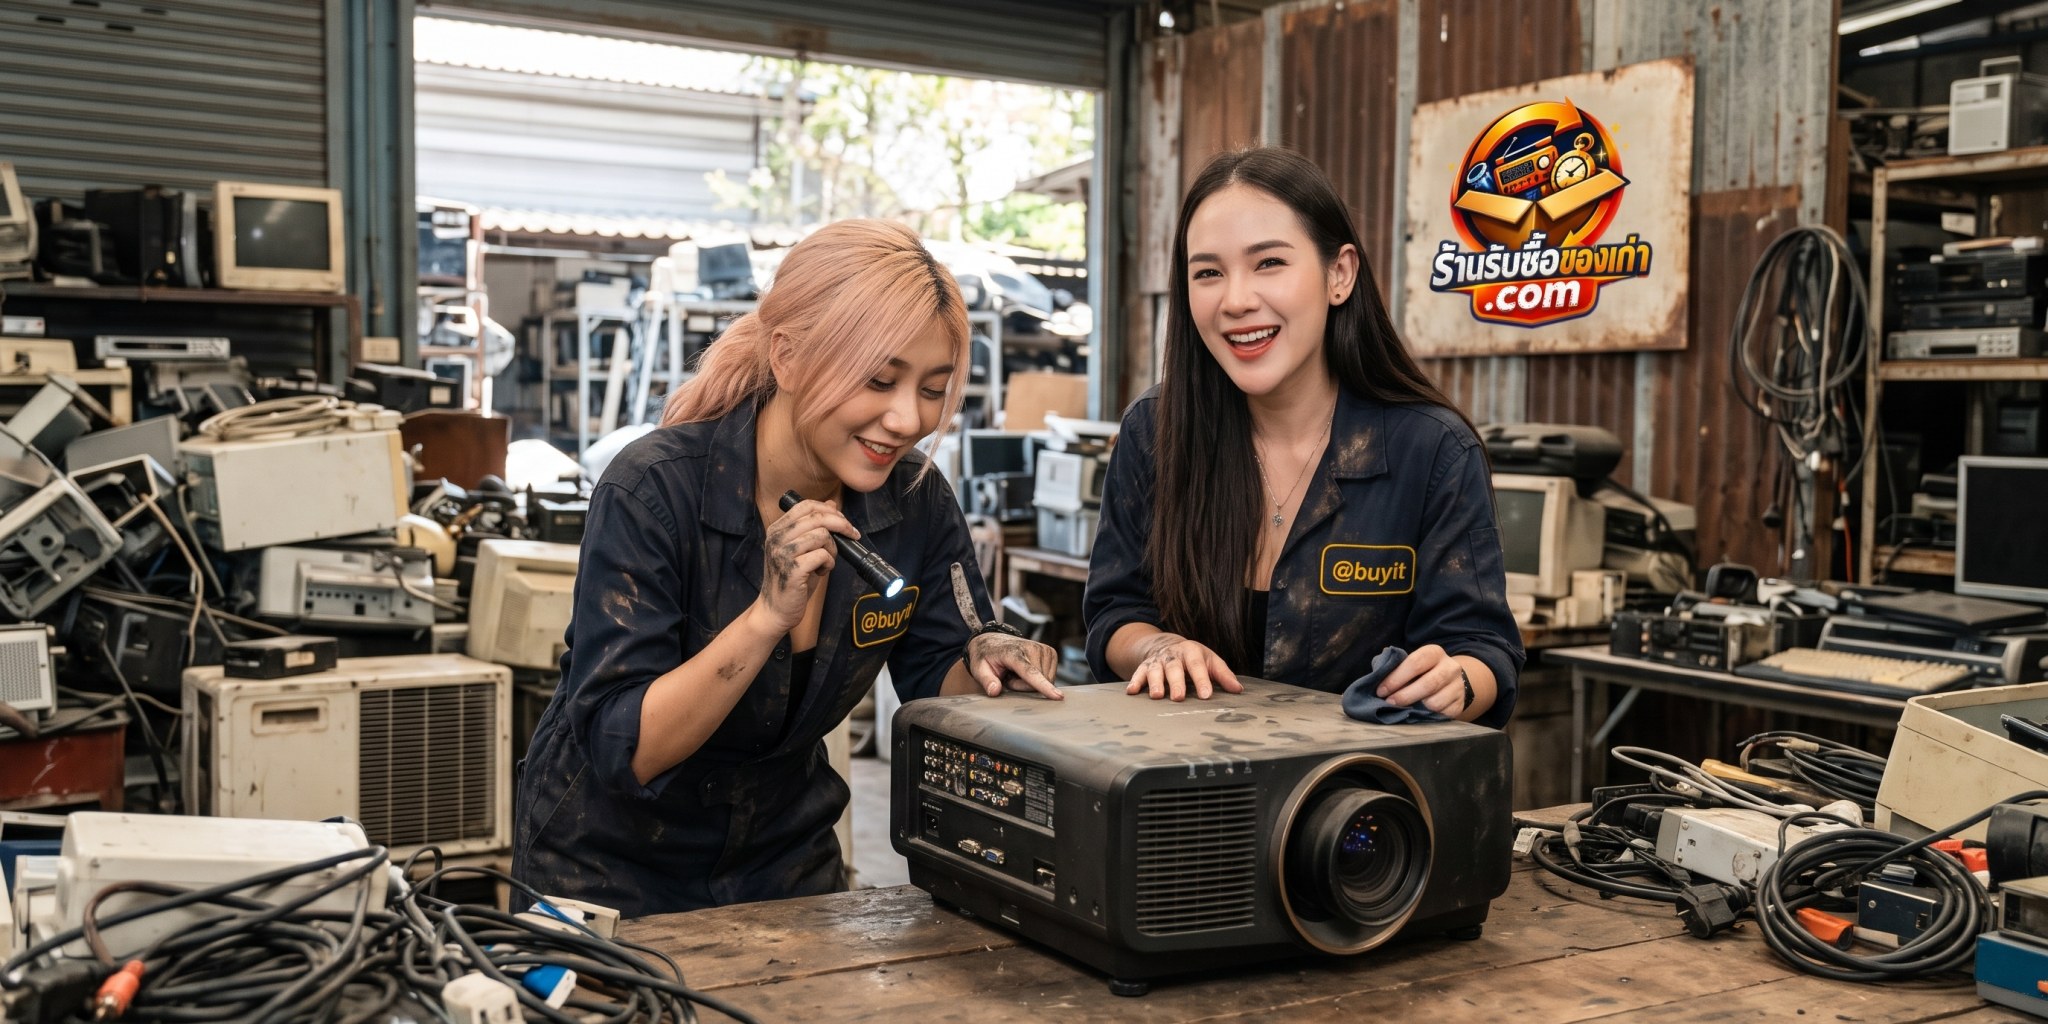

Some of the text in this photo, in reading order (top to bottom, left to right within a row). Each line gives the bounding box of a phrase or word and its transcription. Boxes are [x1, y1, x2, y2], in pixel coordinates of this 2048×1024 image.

[1431, 231, 1651, 287] ร้านรับซื้อของเก่า
[1484, 279, 1581, 312] .com
[1332, 560, 1407, 587] @buyit
[861, 602, 913, 633] @buyit
